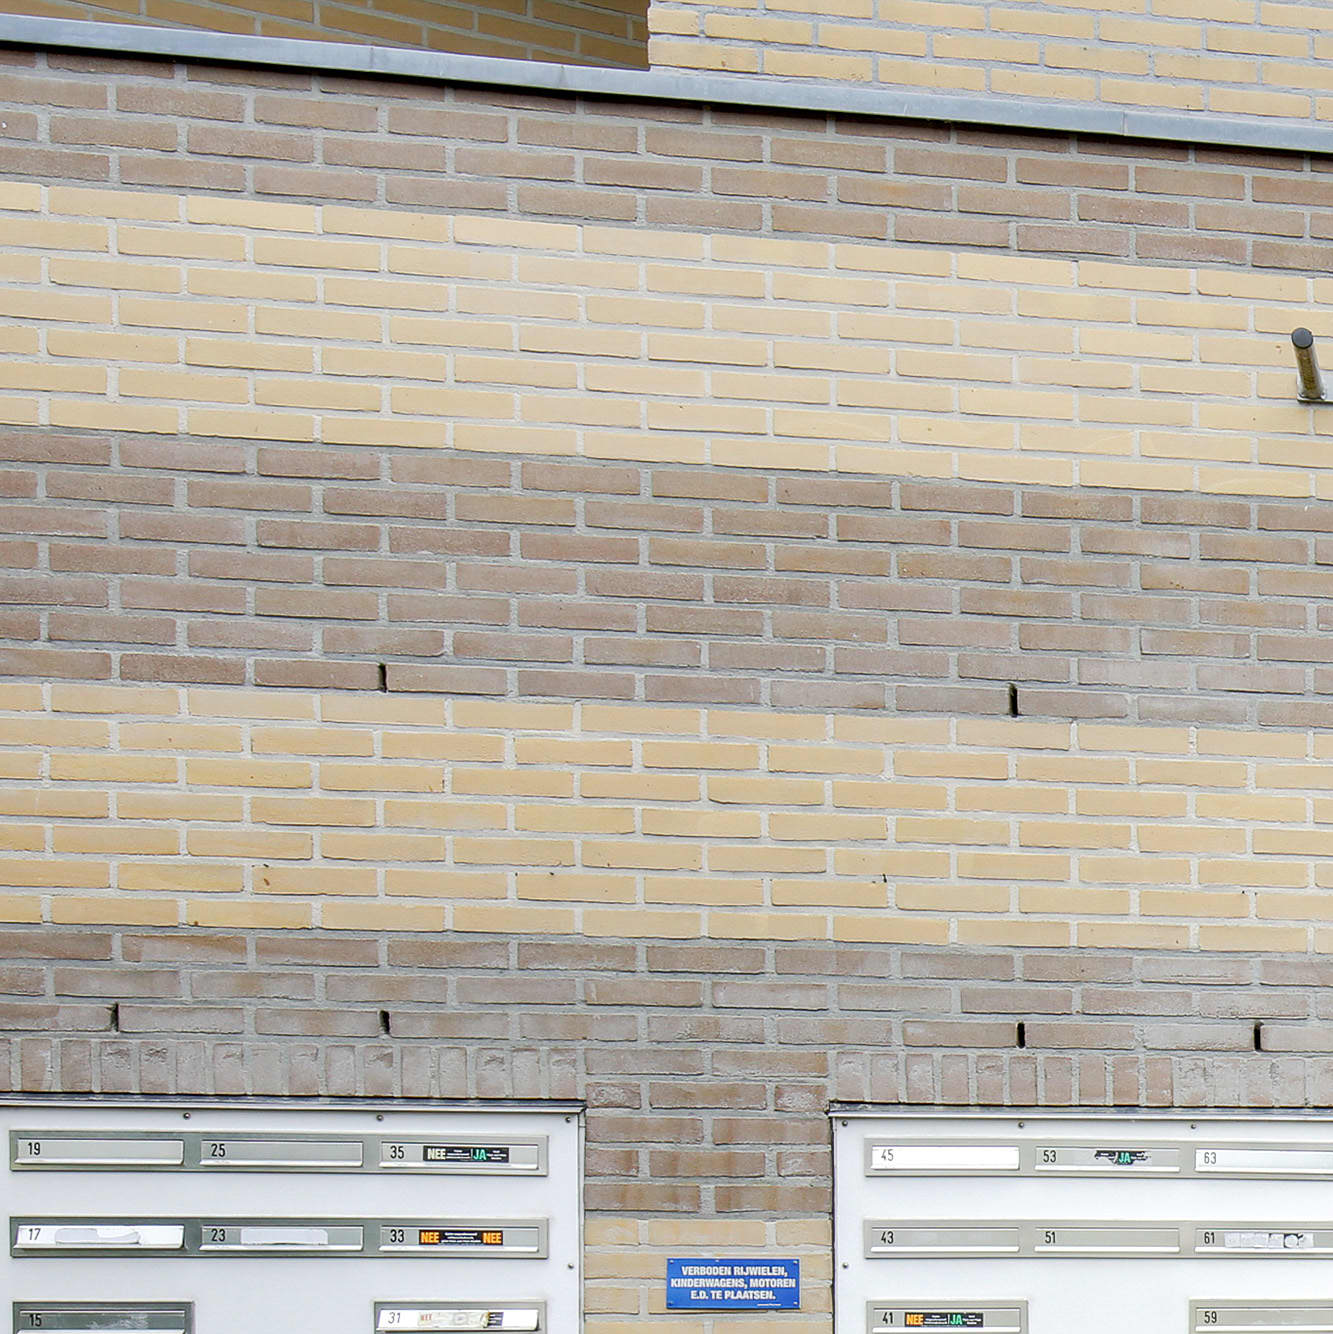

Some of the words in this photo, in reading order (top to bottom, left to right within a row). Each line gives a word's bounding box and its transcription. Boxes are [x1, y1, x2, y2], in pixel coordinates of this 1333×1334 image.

[28, 1142, 41, 1157] 19
[211, 1143, 226, 1157] 25
[390, 1146, 404, 1159] 35
[427, 1148, 446, 1160] NEE
[473, 1148, 487, 1161] JA
[881, 1148, 894, 1162] 45
[1042, 1150, 1057, 1163] 53
[1203, 1151, 1217, 1165] 63
[28, 1228, 41, 1240] 17
[211, 1228, 226, 1242] 23
[390, 1229, 405, 1243] 33
[421, 1232, 440, 1243] NEE
[483, 1232, 502, 1243] NEE
[880, 1231, 894, 1244] 43
[1044, 1231, 1057, 1244] 51
[1203, 1231, 1216, 1245] 61
[681, 1266, 731, 1276] VERBODEN
[733, 1266, 788, 1277] RIJWIELEN,
[670, 1278, 748, 1289] KINDERWAGENS,
[749, 1278, 796, 1288] MOTOREN
[690, 1290, 709, 1300] E.D.
[711, 1290, 722, 1300] TE
[724, 1290, 776, 1300] PLAATSEN.
[29, 1313, 42, 1326] 15
[388, 1312, 401, 1324] 31
[882, 1312, 894, 1324] 41
[906, 1313, 924, 1326] NEE
[950, 1313, 963, 1325] JA
[1203, 1310, 1218, 1324] 59
